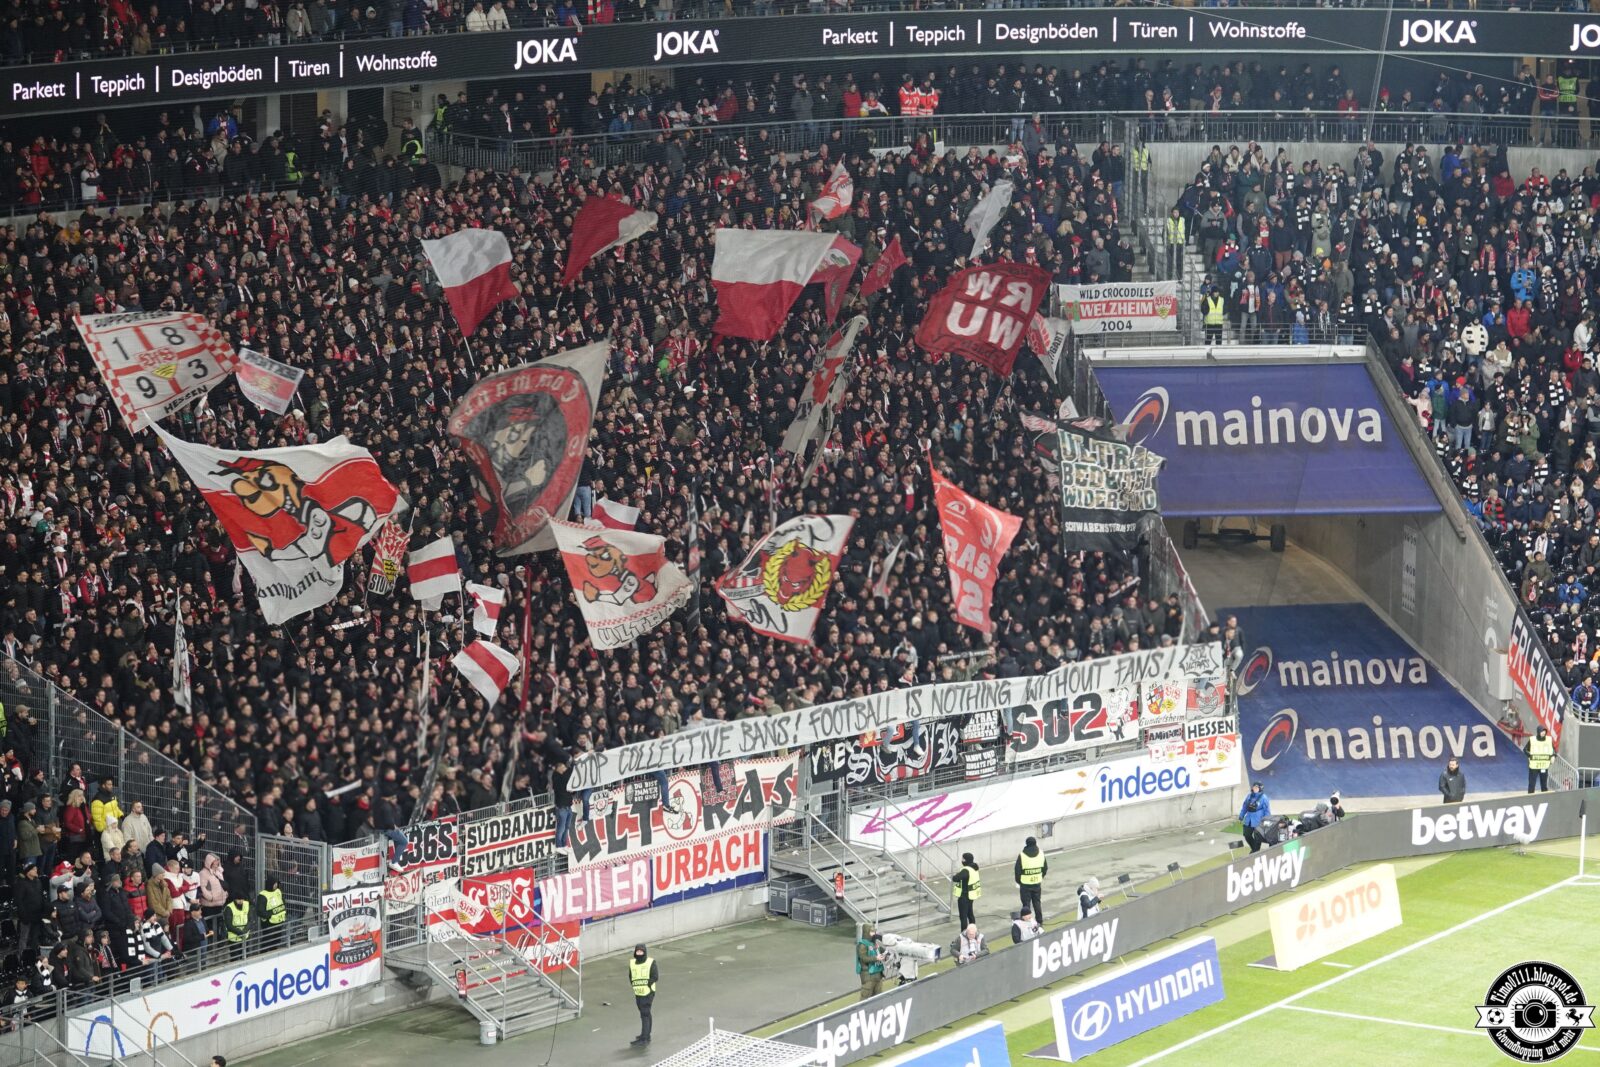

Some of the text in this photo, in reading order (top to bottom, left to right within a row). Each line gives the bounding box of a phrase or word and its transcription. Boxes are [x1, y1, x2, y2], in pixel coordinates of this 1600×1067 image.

[514, 37, 577, 70] JOKA
[654, 30, 719, 62] JOKA
[822, 20, 1307, 48] Parkett Teppich Designböden Türen Wohnstoffe
[1400, 19, 1476, 47] JOKA
[12, 51, 438, 101] Parkett Teppich Designböden Türen Wohnstoffe
[1079, 287, 1154, 299] WILD CROCODILES
[1080, 302, 1153, 318] WELZHEIM
[1101, 320, 1133, 332] 2004
[164, 385, 208, 414] HESSEN
[1174, 395, 1384, 446] mainova
[1277, 651, 1429, 687] mainova
[1508, 614, 1565, 742] ERLENSEE
[570, 648, 1176, 788] STOP COLLECTIVE BANS! FOOTBALL IS NOTHING WITHOUT FANS!
[1187, 719, 1234, 740] HESSEN
[1304, 715, 1497, 760] mainova
[466, 805, 556, 849] SÜDBANDE
[1412, 802, 1549, 846] betway
[466, 840, 557, 876] STUTTGART
[655, 829, 762, 892] URBACH
[1226, 845, 1307, 903] betway
[539, 857, 649, 923] WEILER
[1320, 880, 1382, 929] LOTTO
[1032, 917, 1119, 979] betway
[234, 953, 330, 1015] indeed
[1115, 959, 1215, 1024] HYUNDAI
[817, 998, 913, 1063] betway
